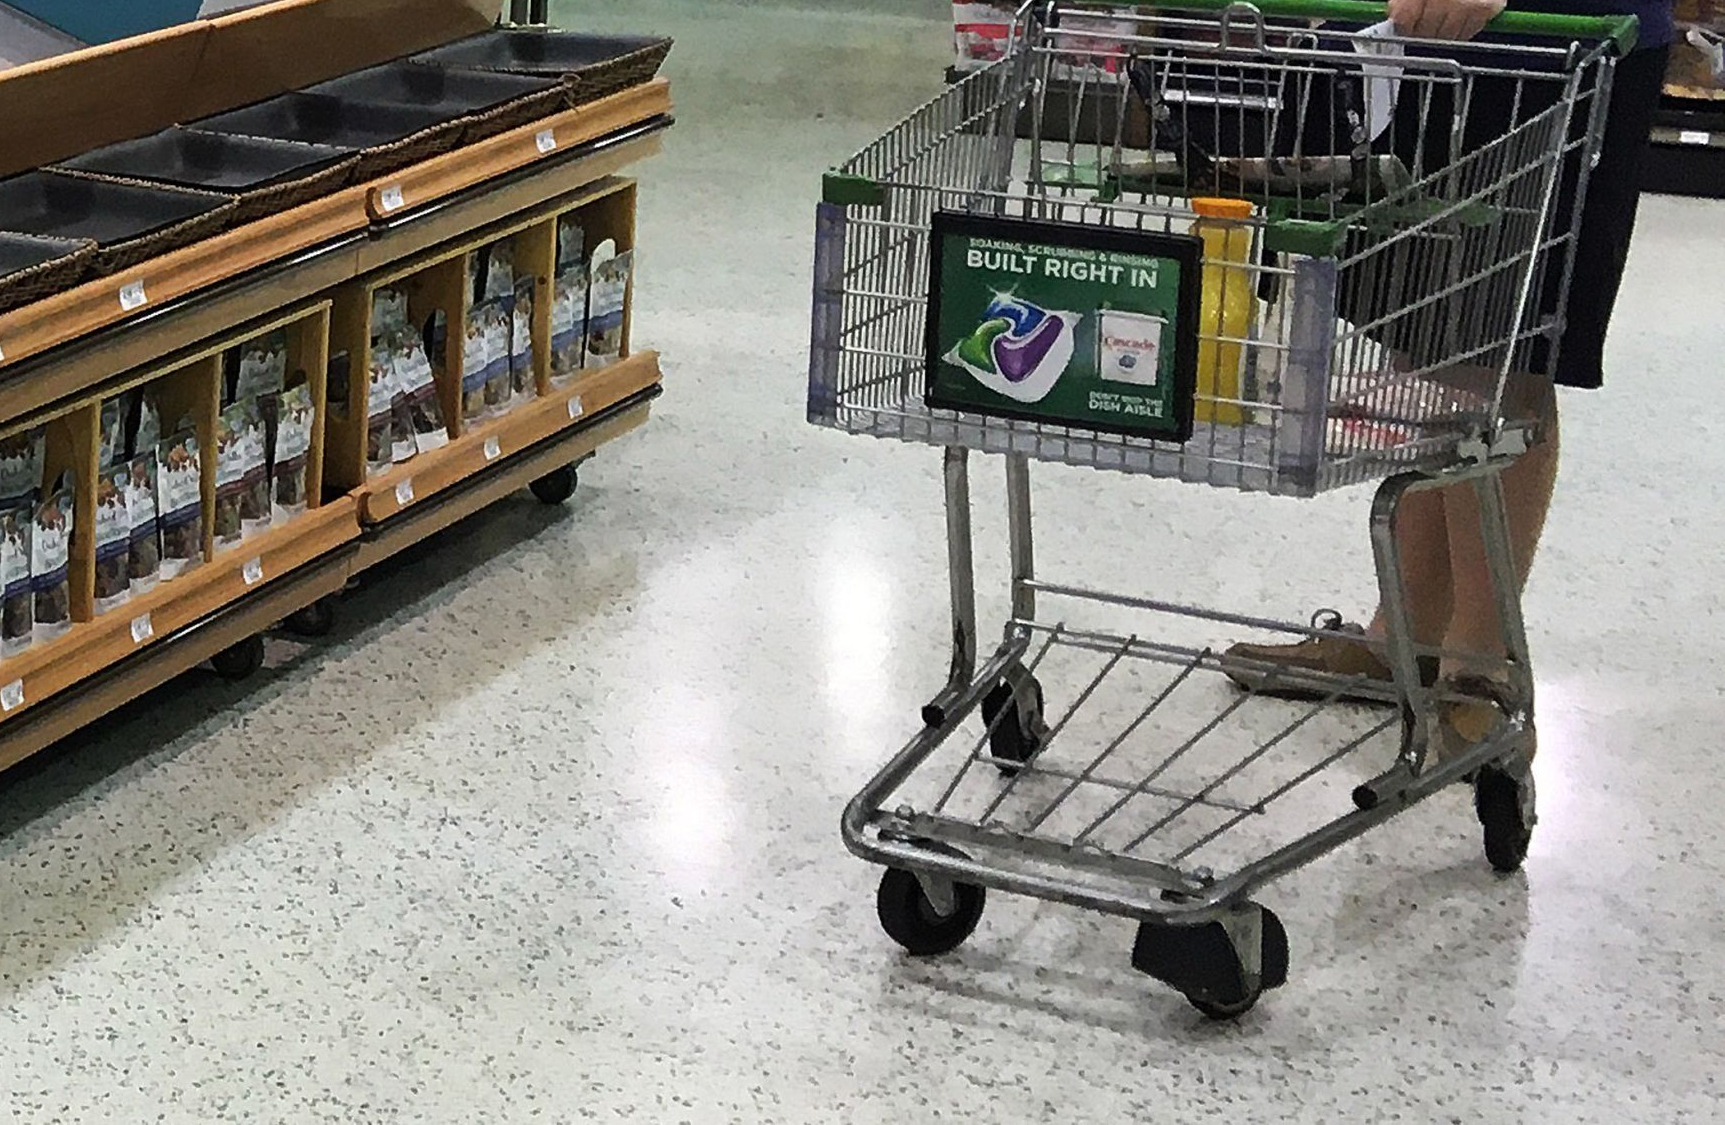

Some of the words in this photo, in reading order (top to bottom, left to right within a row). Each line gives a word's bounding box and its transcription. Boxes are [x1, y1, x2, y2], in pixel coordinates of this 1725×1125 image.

[1027, 245, 1096, 262] SCRUBBING
[1098, 252, 1108, 262] &
[1110, 252, 1160, 269] RINSING
[967, 249, 1038, 275] BUILT
[1045, 258, 1124, 286] RIGHT
[1130, 268, 1159, 290] IN
[1089, 399, 1121, 412] DISH
[1124, 403, 1164, 418] AISLE
